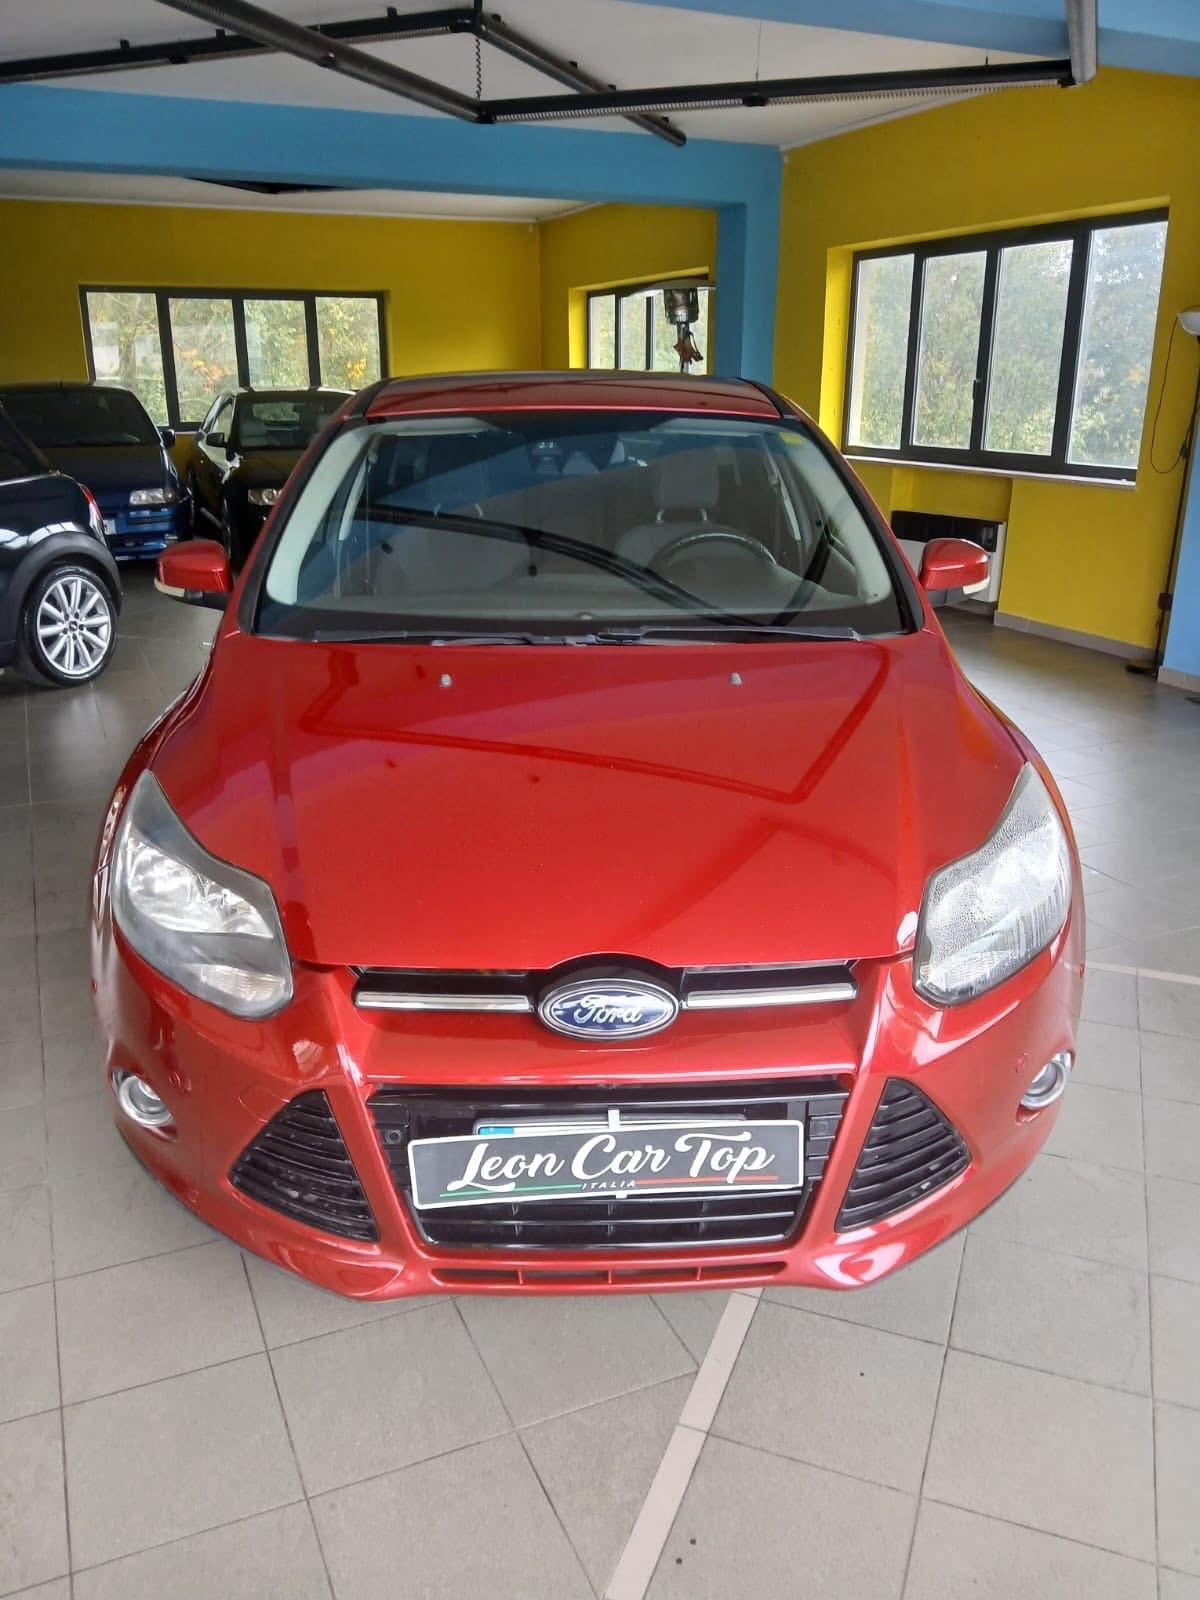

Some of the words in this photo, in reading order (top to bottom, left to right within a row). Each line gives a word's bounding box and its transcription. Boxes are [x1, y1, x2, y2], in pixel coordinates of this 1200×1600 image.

[573, 994, 642, 1024] Ford
[447, 1143, 565, 1193] Leon
[571, 1134, 671, 1180] Car
[674, 1131, 775, 1184] Top
[581, 1180, 636, 1190] ITALIA
